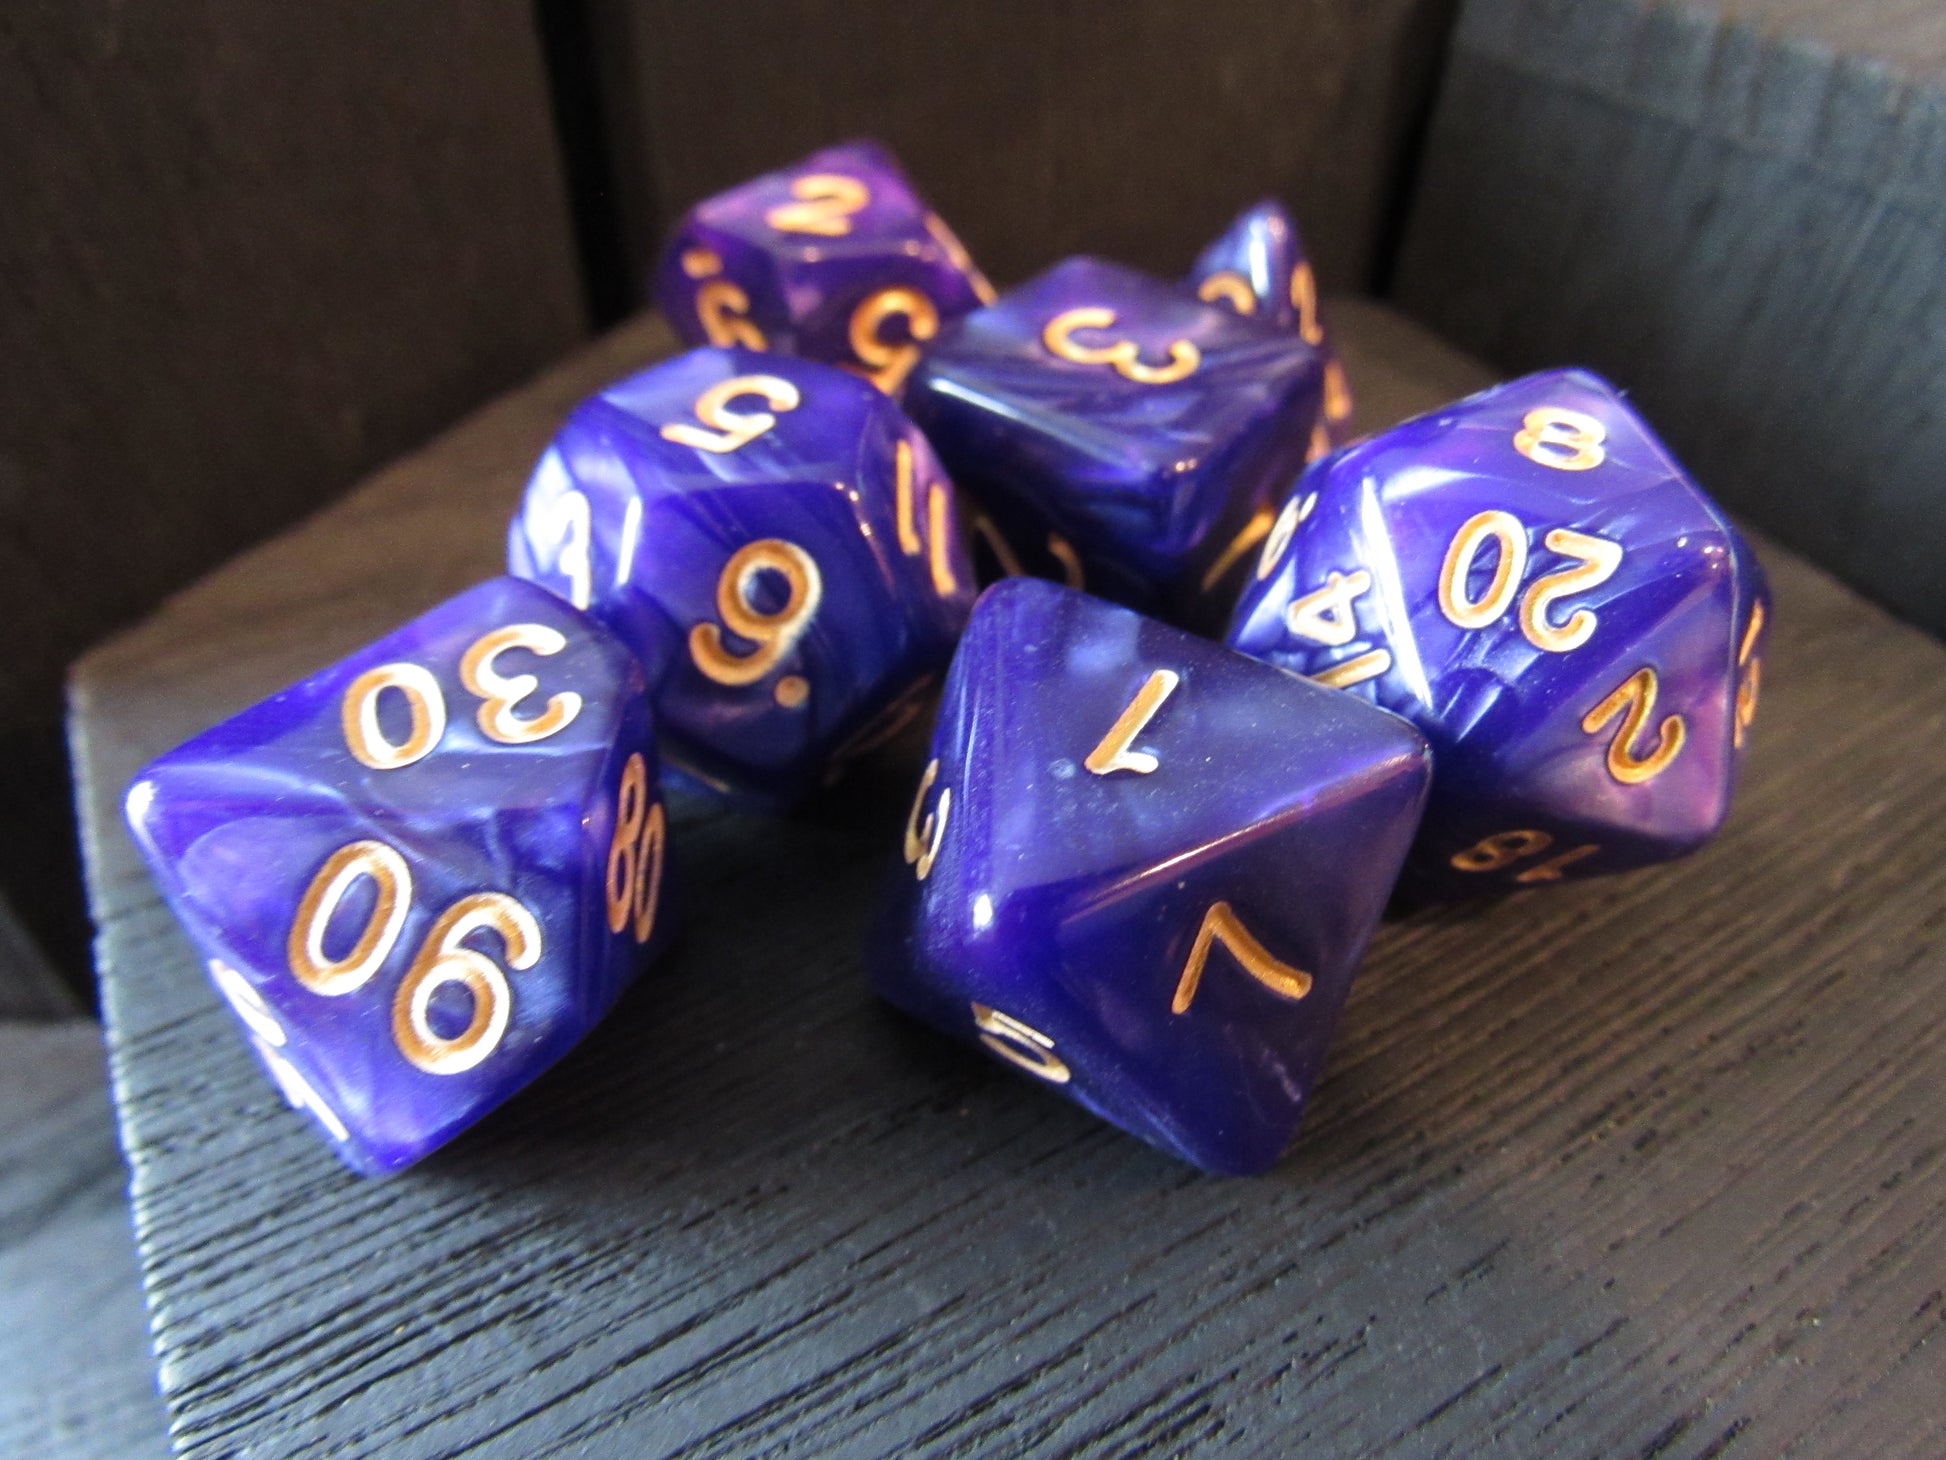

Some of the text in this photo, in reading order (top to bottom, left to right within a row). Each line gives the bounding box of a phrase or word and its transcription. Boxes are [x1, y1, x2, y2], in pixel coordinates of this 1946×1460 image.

[766, 173, 869, 237] 2
[1043, 307, 1201, 384] 3
[661, 375, 800, 453] 5
[1513, 406, 1607, 471] 8
[1286, 571, 1392, 690] 14
[1438, 509, 1624, 653] 20
[341, 622, 583, 770] 30
[1084, 669, 1180, 775] 1
[1582, 666, 1687, 785] 2
[606, 752, 666, 945] 80
[1172, 901, 1313, 1015] 7
